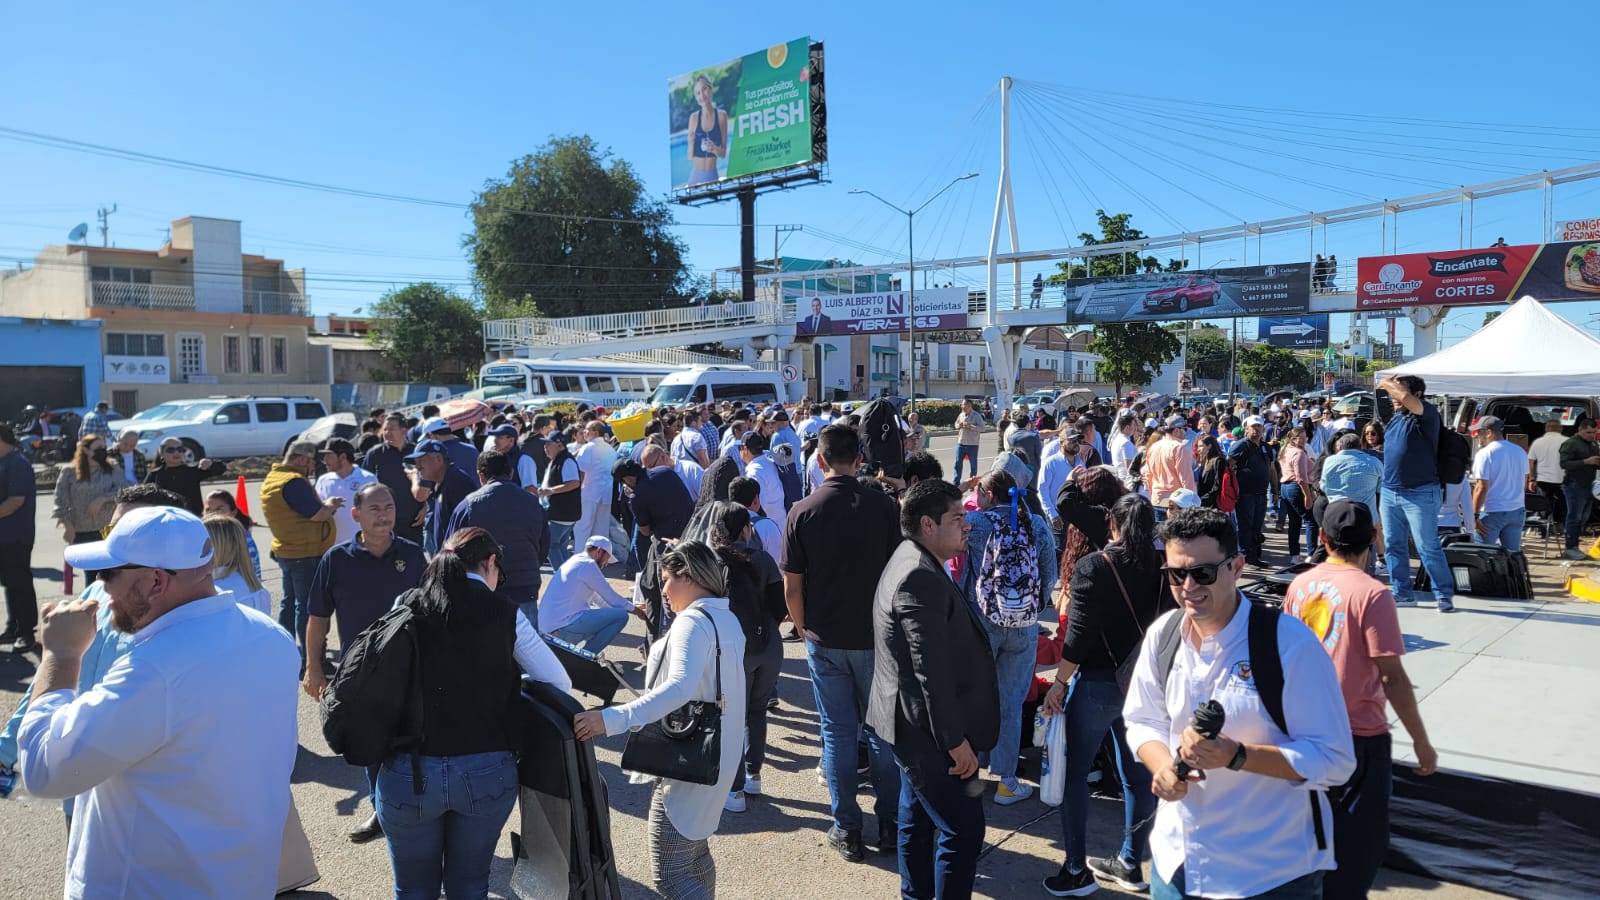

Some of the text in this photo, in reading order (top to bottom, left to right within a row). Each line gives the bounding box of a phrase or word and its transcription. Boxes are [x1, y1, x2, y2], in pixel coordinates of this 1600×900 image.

[745, 80, 794, 100] Tus propósitos
[745, 87, 799, 110] se cumplen más
[738, 99, 805, 138] FRESH
[1435, 256, 1498, 272] Encántate
[1435, 284, 1496, 298] CORTES
[825, 296, 884, 308] LUIS ALBERTO
[851, 307, 883, 318] DÍAZ EN
[603, 398, 624, 407] LINEAS
